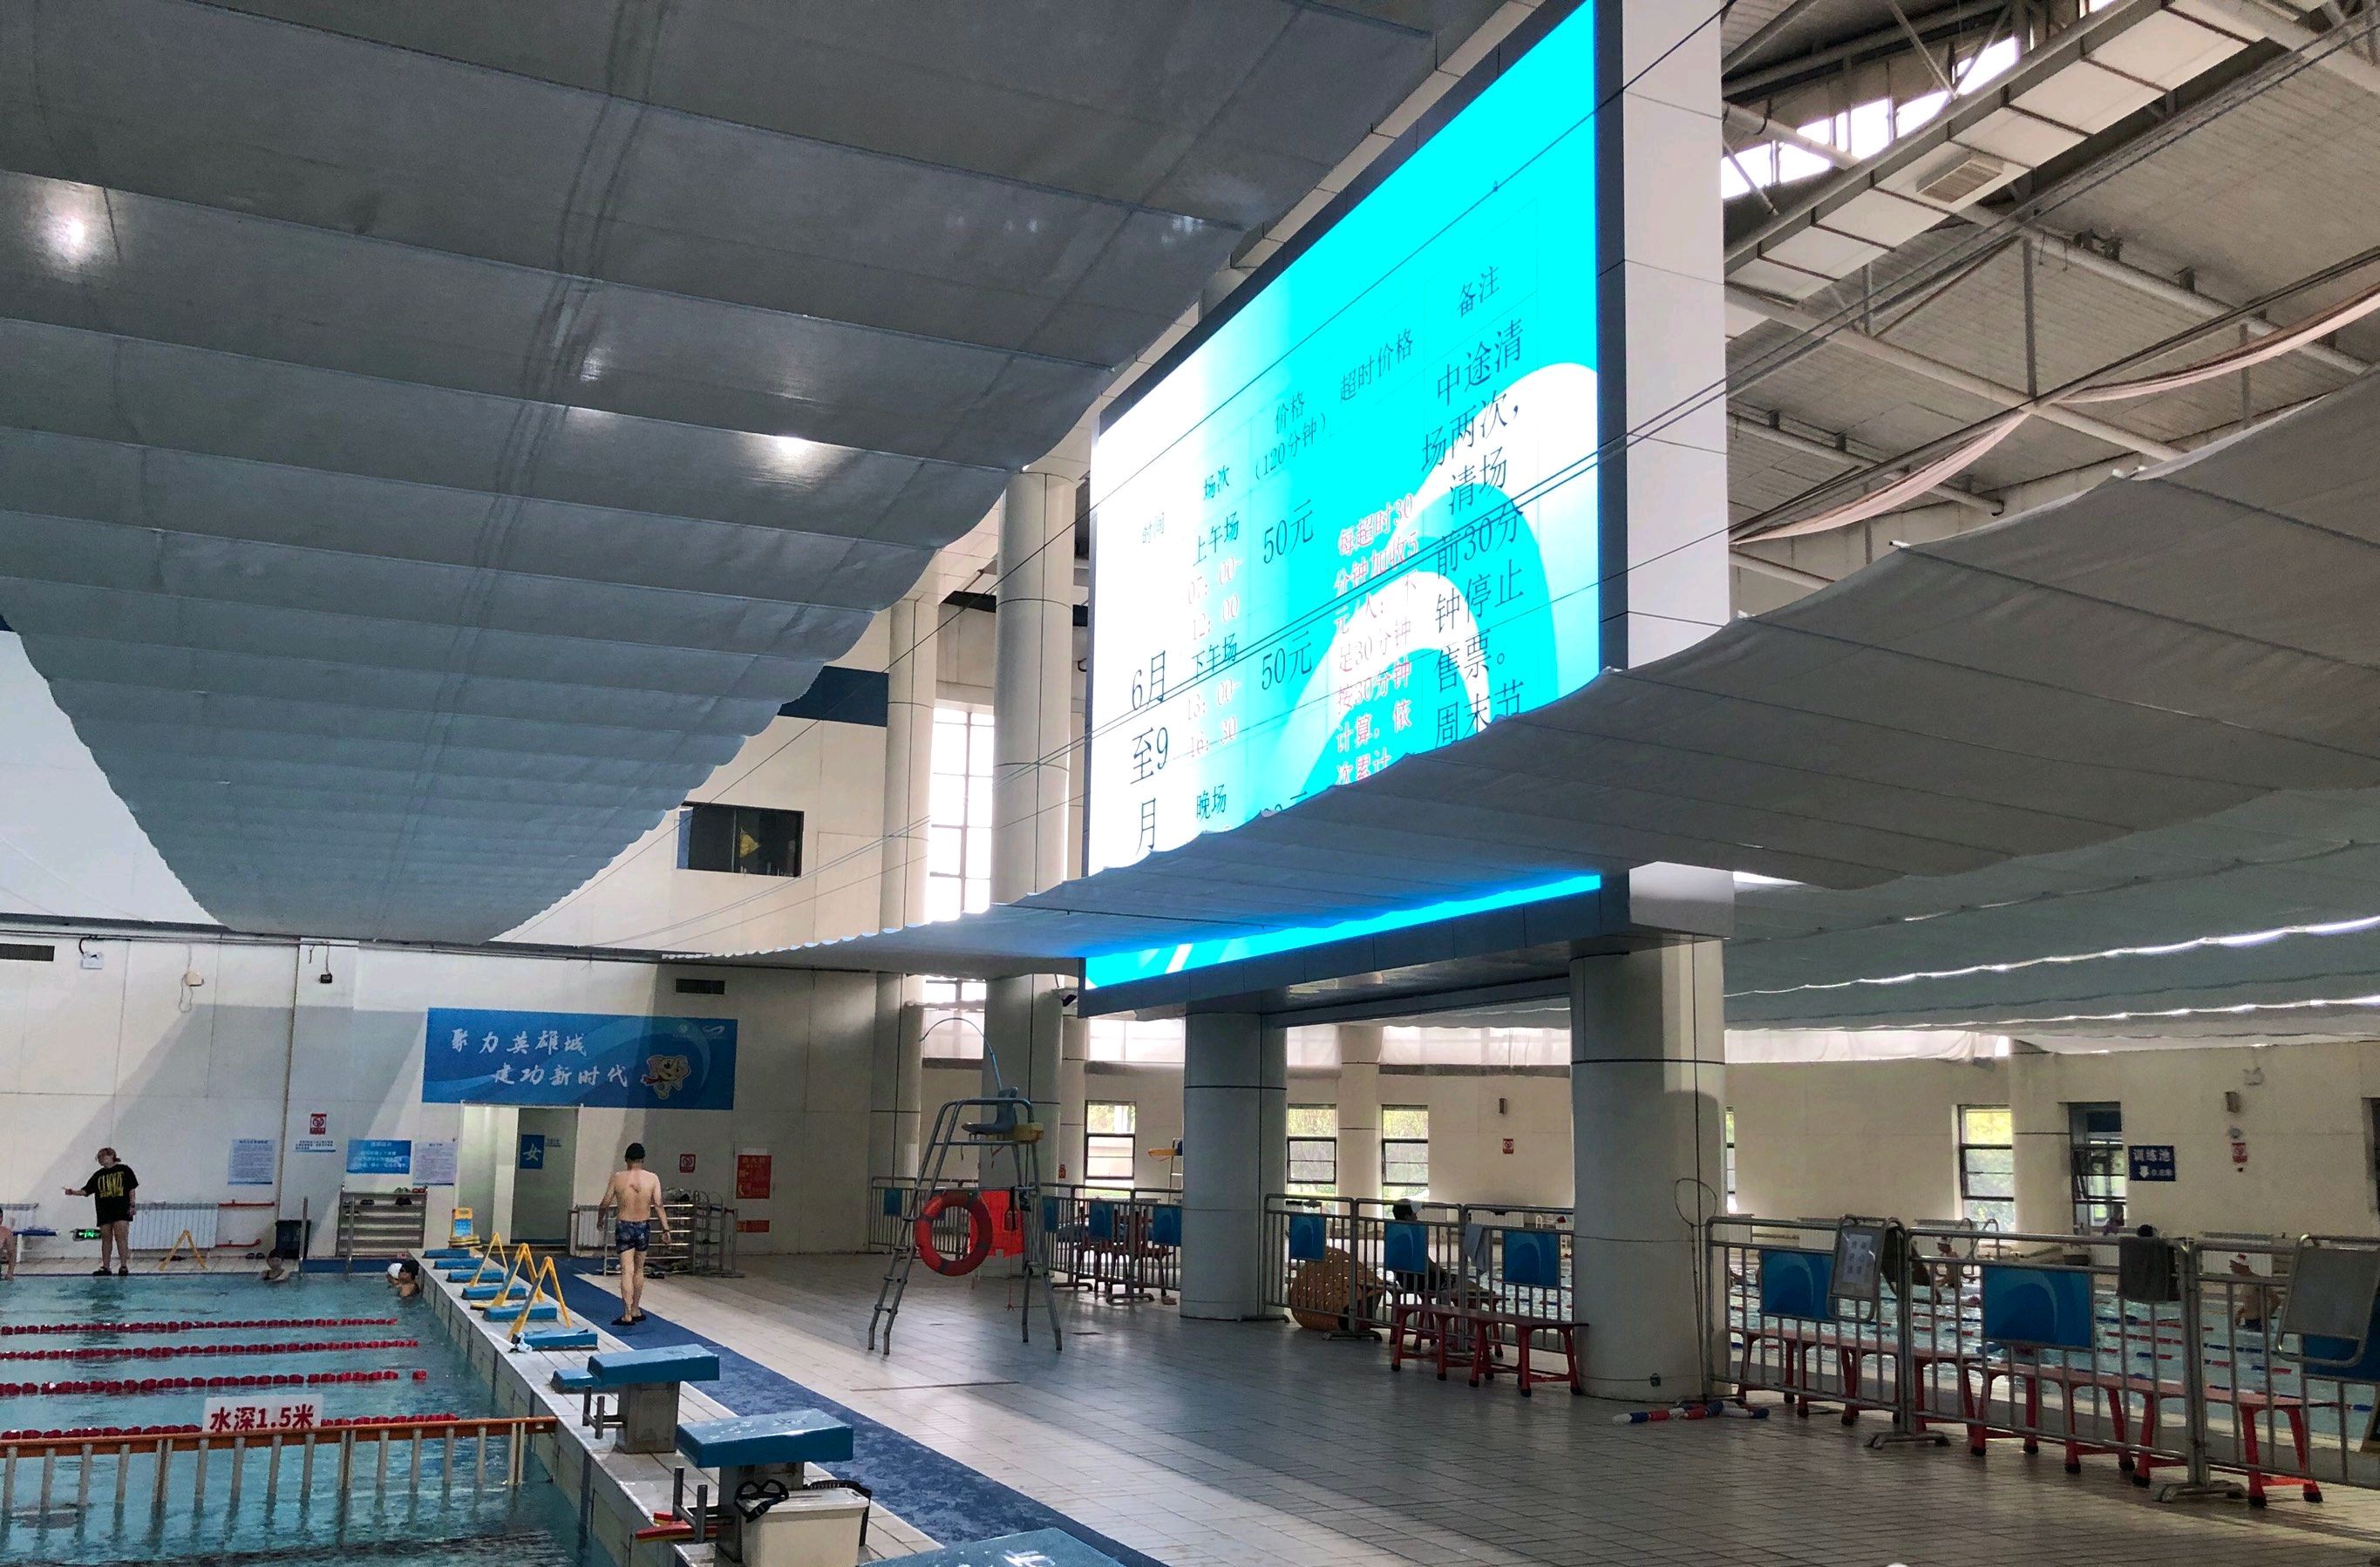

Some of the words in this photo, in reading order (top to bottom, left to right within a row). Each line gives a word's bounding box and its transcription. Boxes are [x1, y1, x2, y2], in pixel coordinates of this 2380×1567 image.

[1457, 266, 1499, 318] 备注
[1340, 329, 1413, 404] 超时价格
[1438, 319, 1523, 406] 中途清
[1275, 391, 1304, 434] 价格
[1448, 446, 1508, 515] 清场
[1193, 511, 1240, 566] 上午场
[1262, 499, 1315, 565] 50元
[1338, 493, 1413, 556] 每超时30
[1434, 498, 1524, 579] 前30分
[1435, 559, 1525, 634] 钟停止
[1132, 649, 1166, 711] 6月
[1191, 632, 1238, 681] 下午场
[1261, 630, 1313, 691] 50元
[1435, 628, 1505, 693] 售票。
[1130, 726, 1169, 784] 至9
[1136, 797, 1156, 854] 月
[1195, 784, 1227, 822] 晚场
[452, 1028, 587, 1057] 聚力英雄城
[493, 1062, 628, 1089] 建功新时代
[523, 1143, 542, 1163] 女
[209, 1403, 314, 1432] 水深1.5米
